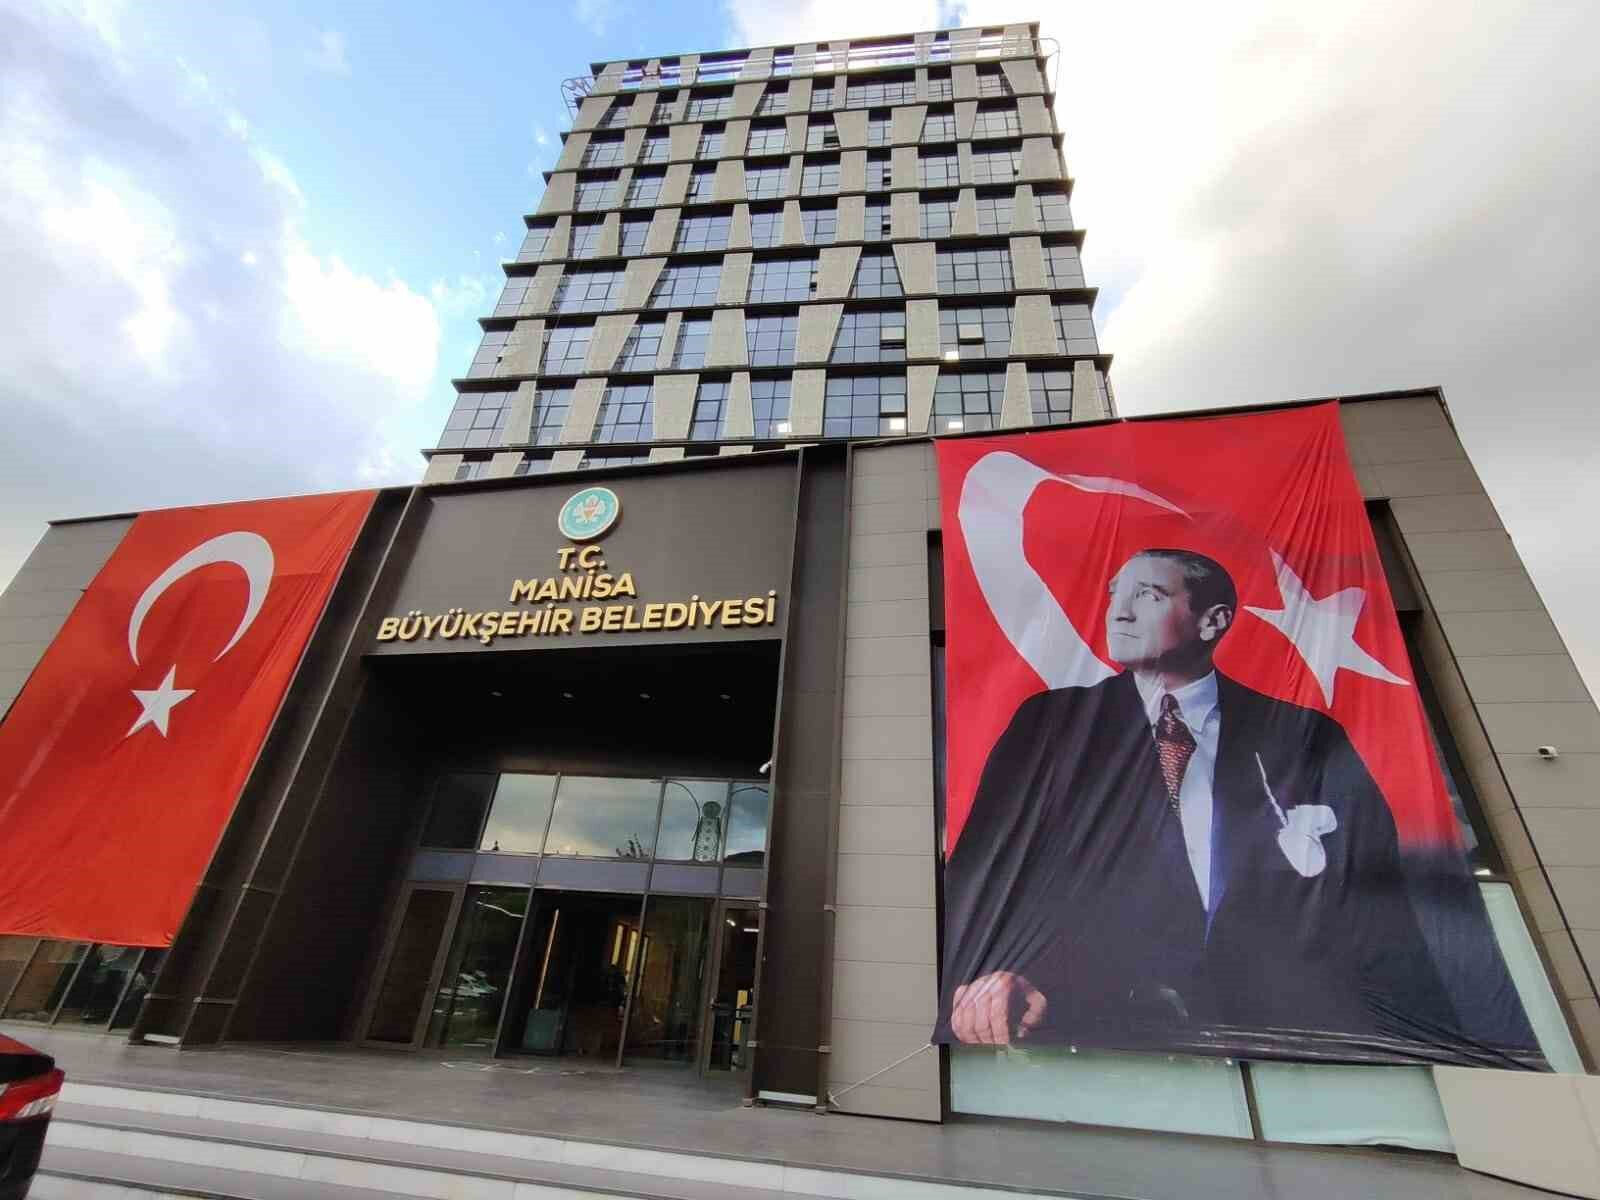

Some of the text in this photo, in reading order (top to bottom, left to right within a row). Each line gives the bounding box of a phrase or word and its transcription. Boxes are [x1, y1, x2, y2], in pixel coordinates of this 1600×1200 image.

[557, 545, 605, 570] T.C.
[510, 569, 636, 602] MANİSA
[377, 590, 776, 643] BÜYÜKŞEHİR BELEDİYESİ
